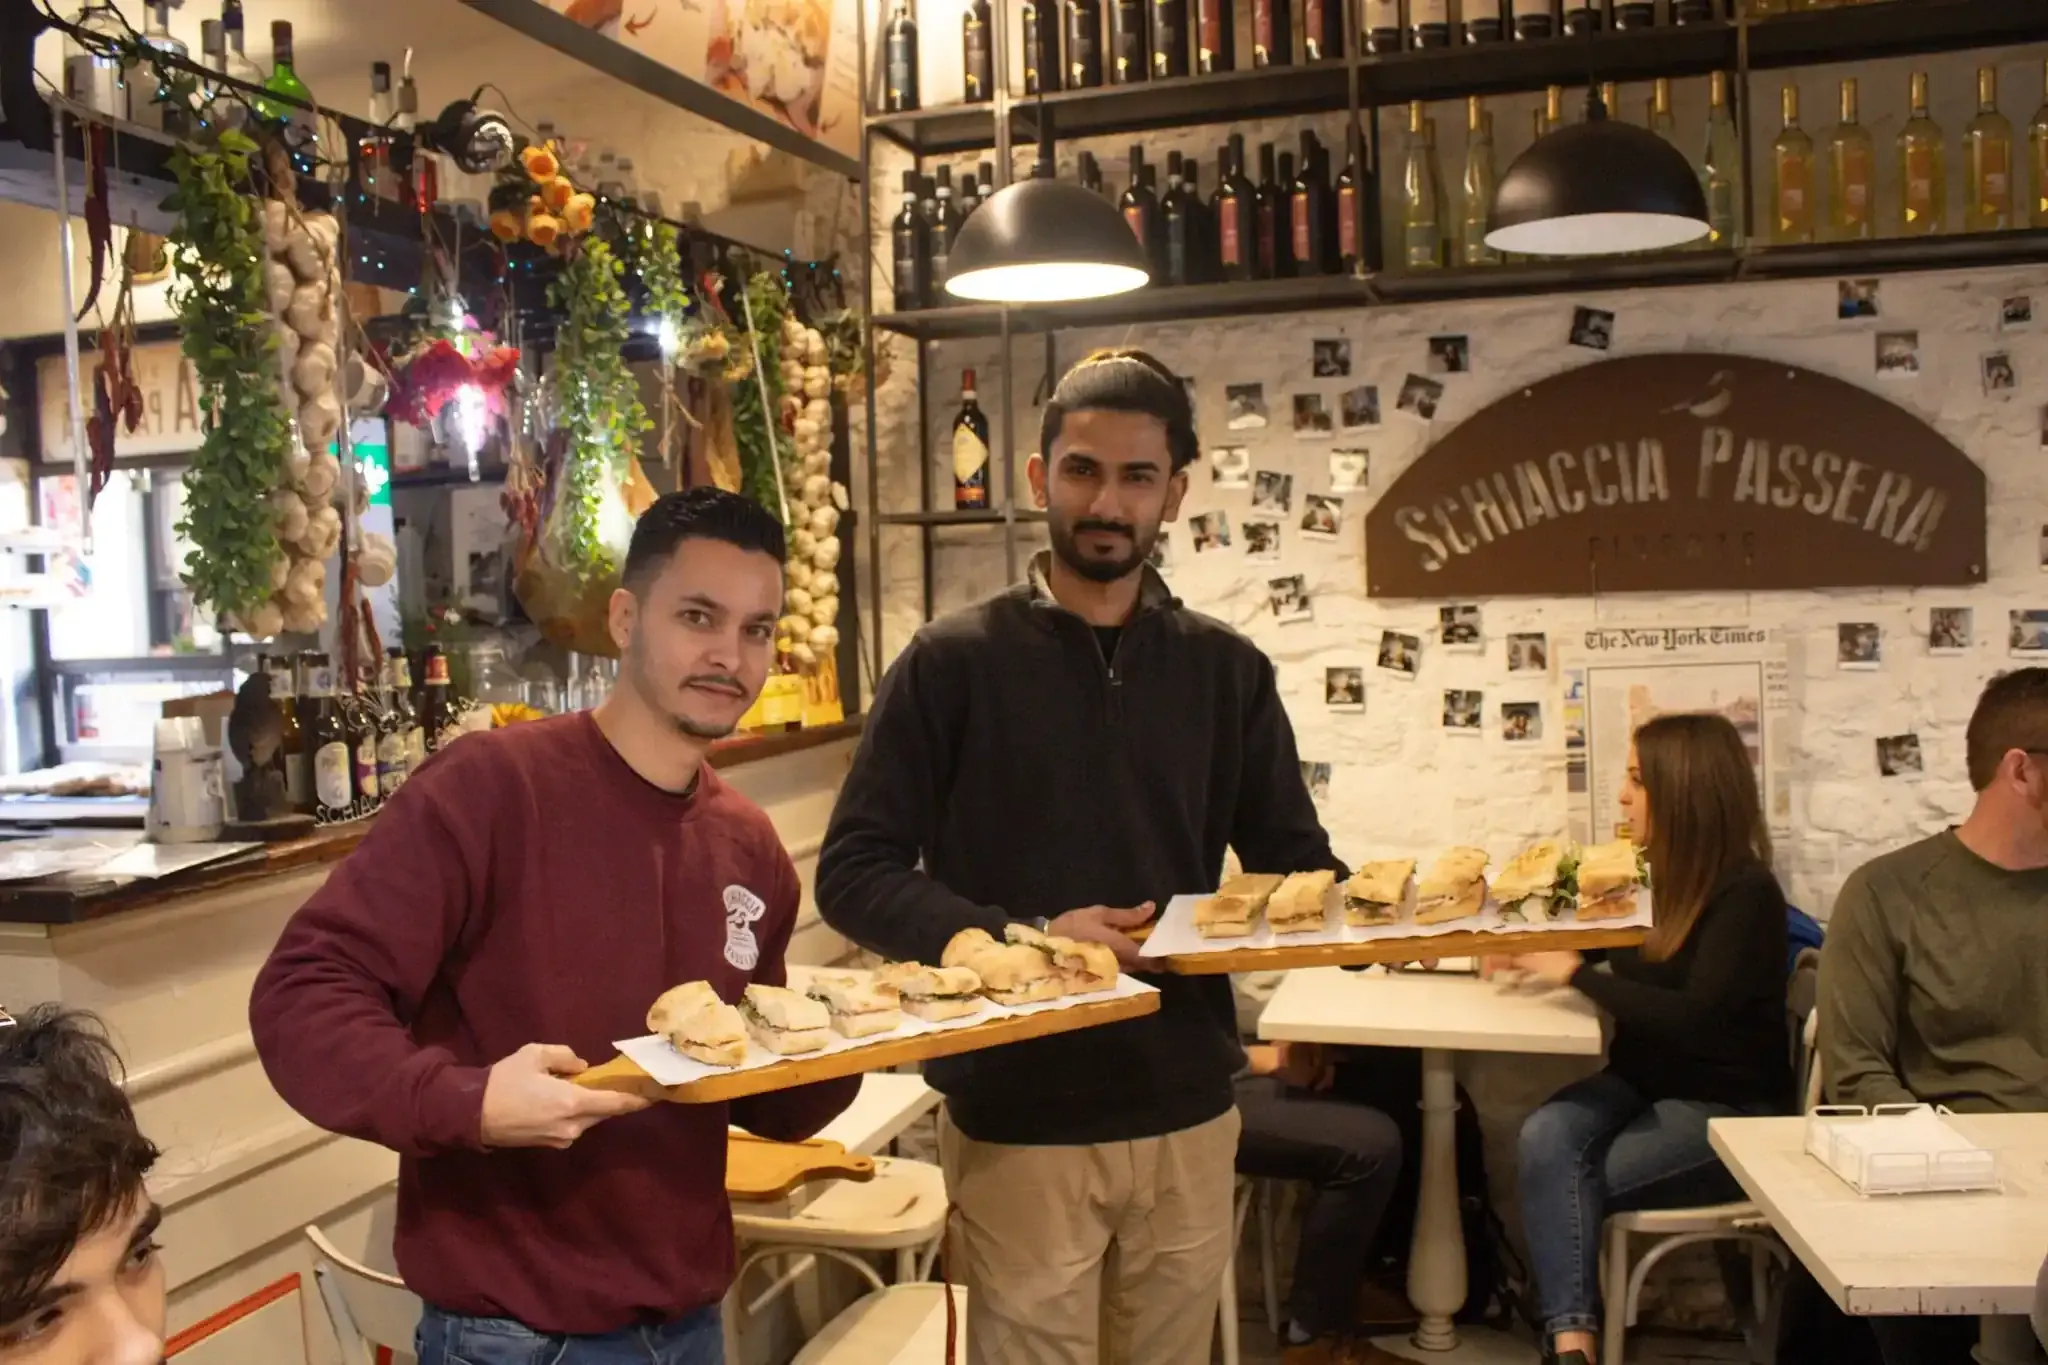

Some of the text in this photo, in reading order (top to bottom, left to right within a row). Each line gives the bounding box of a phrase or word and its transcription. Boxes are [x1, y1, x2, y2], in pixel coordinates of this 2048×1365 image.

[1394, 426, 1947, 572] SCHIACCIA PASSERA
[1584, 627, 1767, 650] The New York Times
